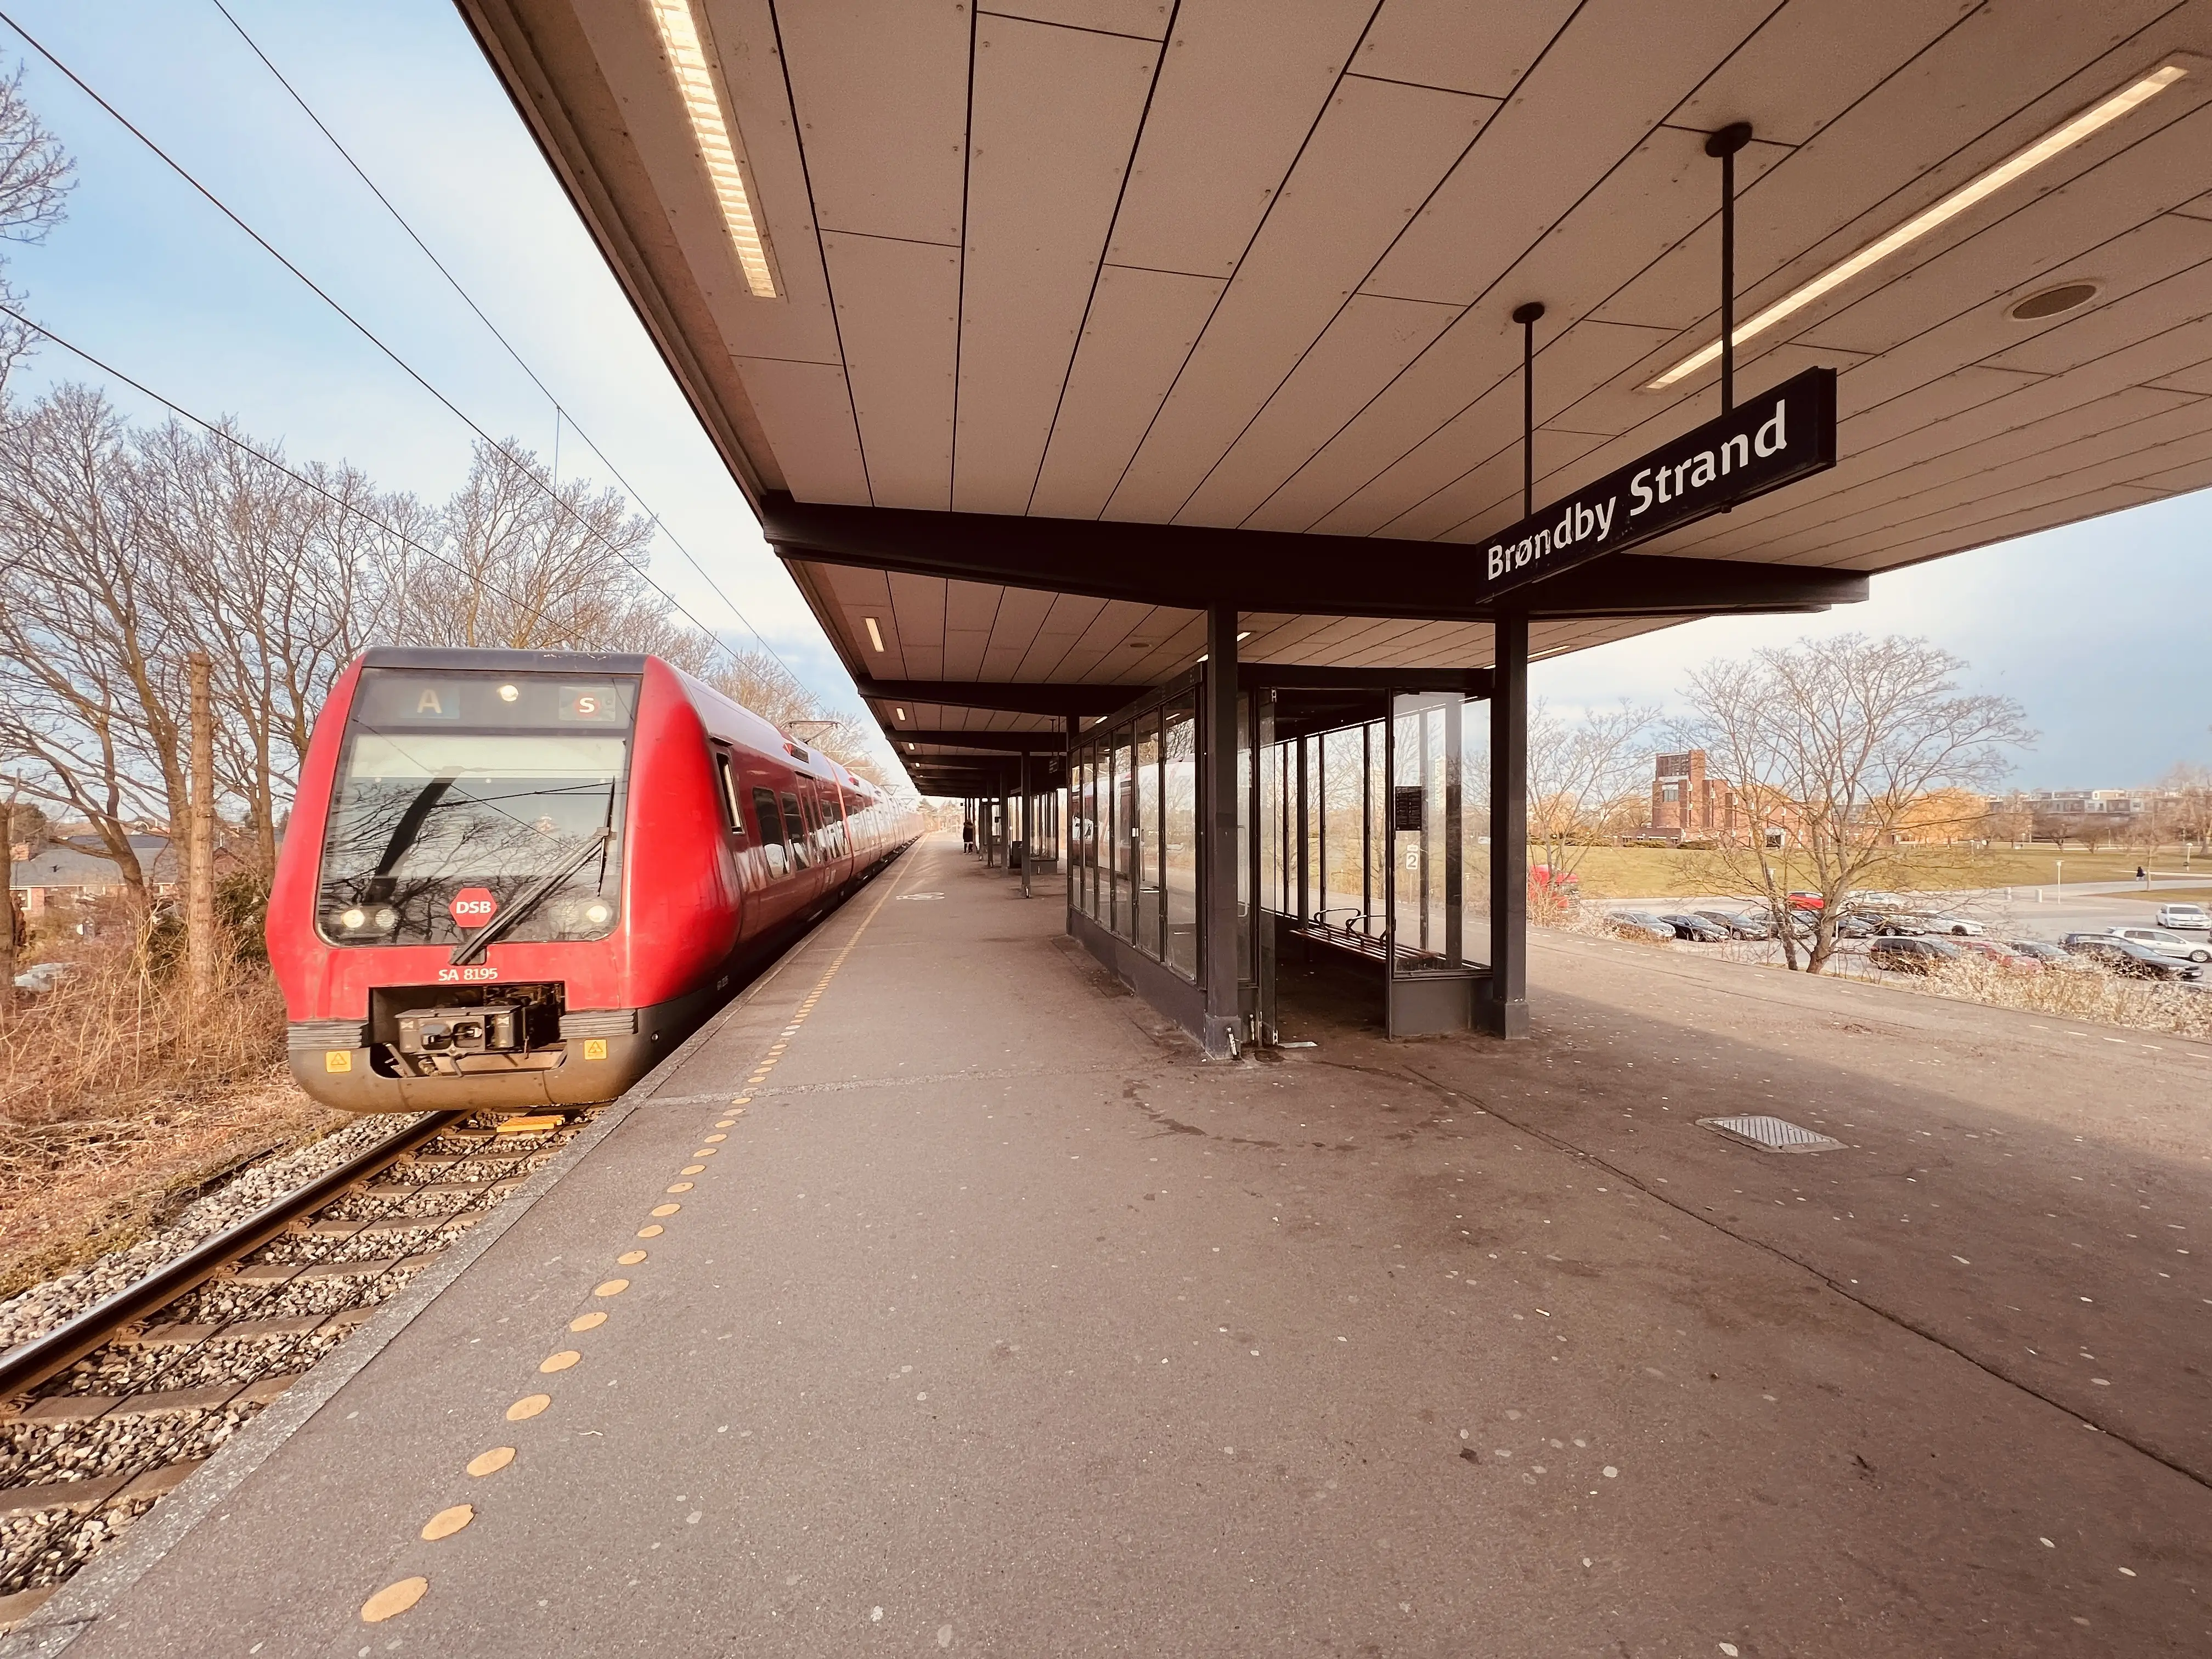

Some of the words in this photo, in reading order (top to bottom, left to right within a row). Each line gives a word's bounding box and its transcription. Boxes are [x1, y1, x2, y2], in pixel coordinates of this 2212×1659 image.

[1487, 496, 1616, 580] Brøndby
[1630, 399, 1787, 516] Strand
[417, 689, 442, 714] A
[579, 697, 595, 713] S
[1408, 854, 1417, 868] 2
[456, 901, 492, 915] DSB
[438, 969, 459, 981] SA
[464, 967, 499, 980] 8195
